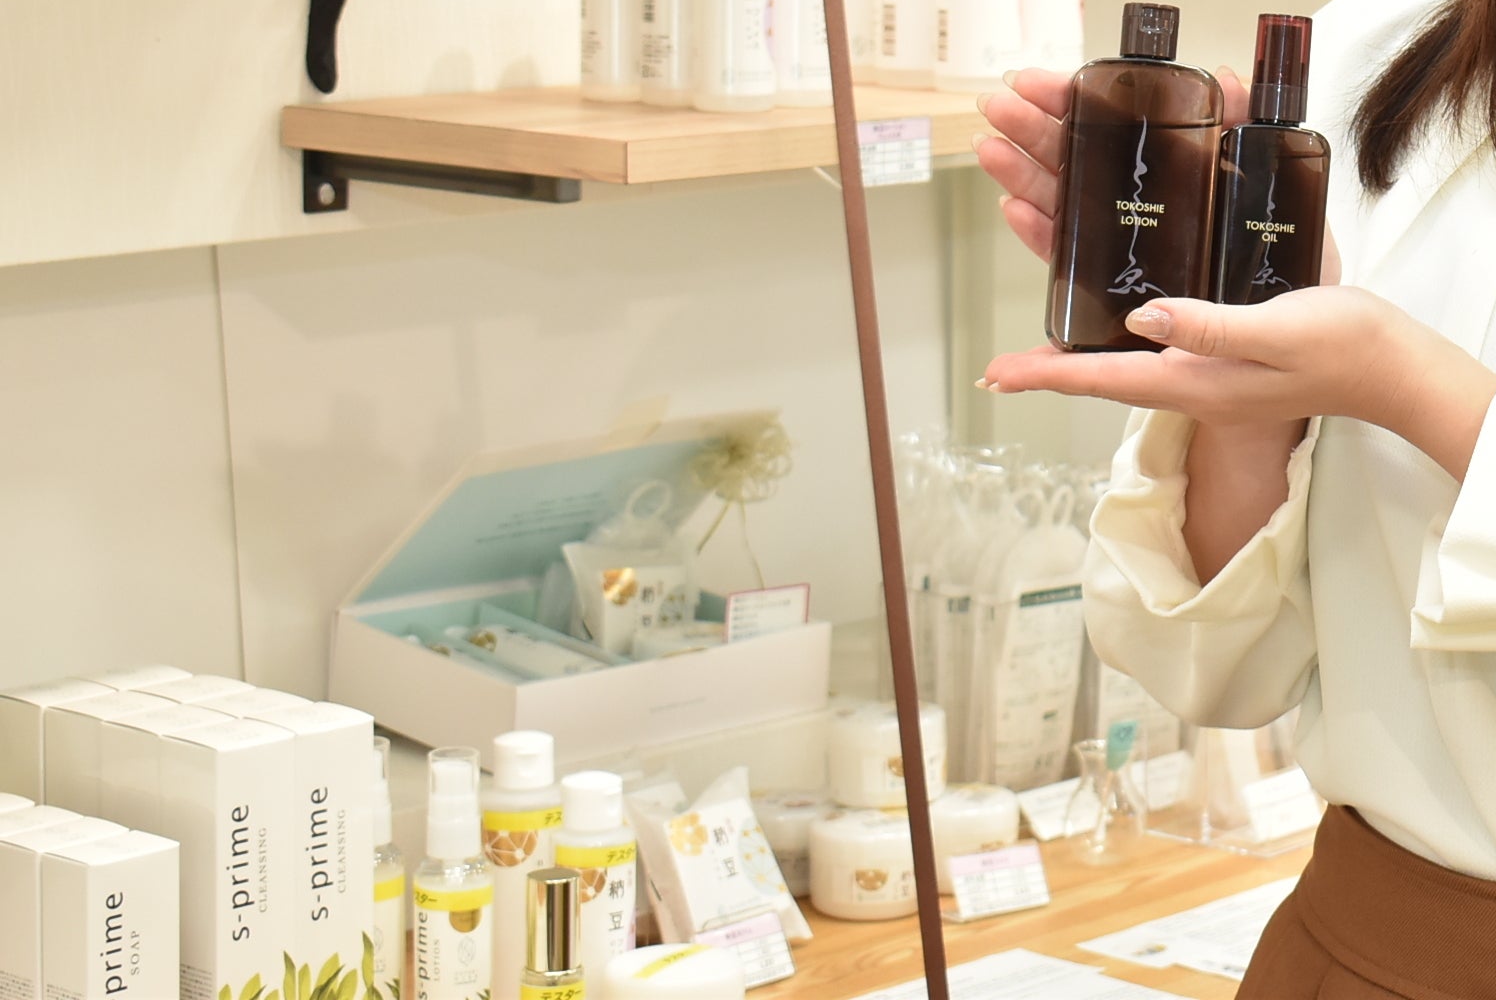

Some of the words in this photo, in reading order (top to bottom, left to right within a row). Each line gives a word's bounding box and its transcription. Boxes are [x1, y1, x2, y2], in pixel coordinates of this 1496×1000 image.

[1116, 200, 1165, 214] TOKOSHIE
[1120, 215, 1158, 228] LOTION
[1245, 220, 1296, 234] TOKOSHIE
[1261, 232, 1278, 243] OIL
[226, 804, 255, 942] s-prime
[258, 826, 268, 913] CLEANSING
[305, 786, 334, 922] s-prime
[337, 809, 346, 894] CLEANSING
[607, 879, 625, 932] 納豆
[130, 930, 140, 976] SOAP
[417, 911, 434, 1000] s-prime
